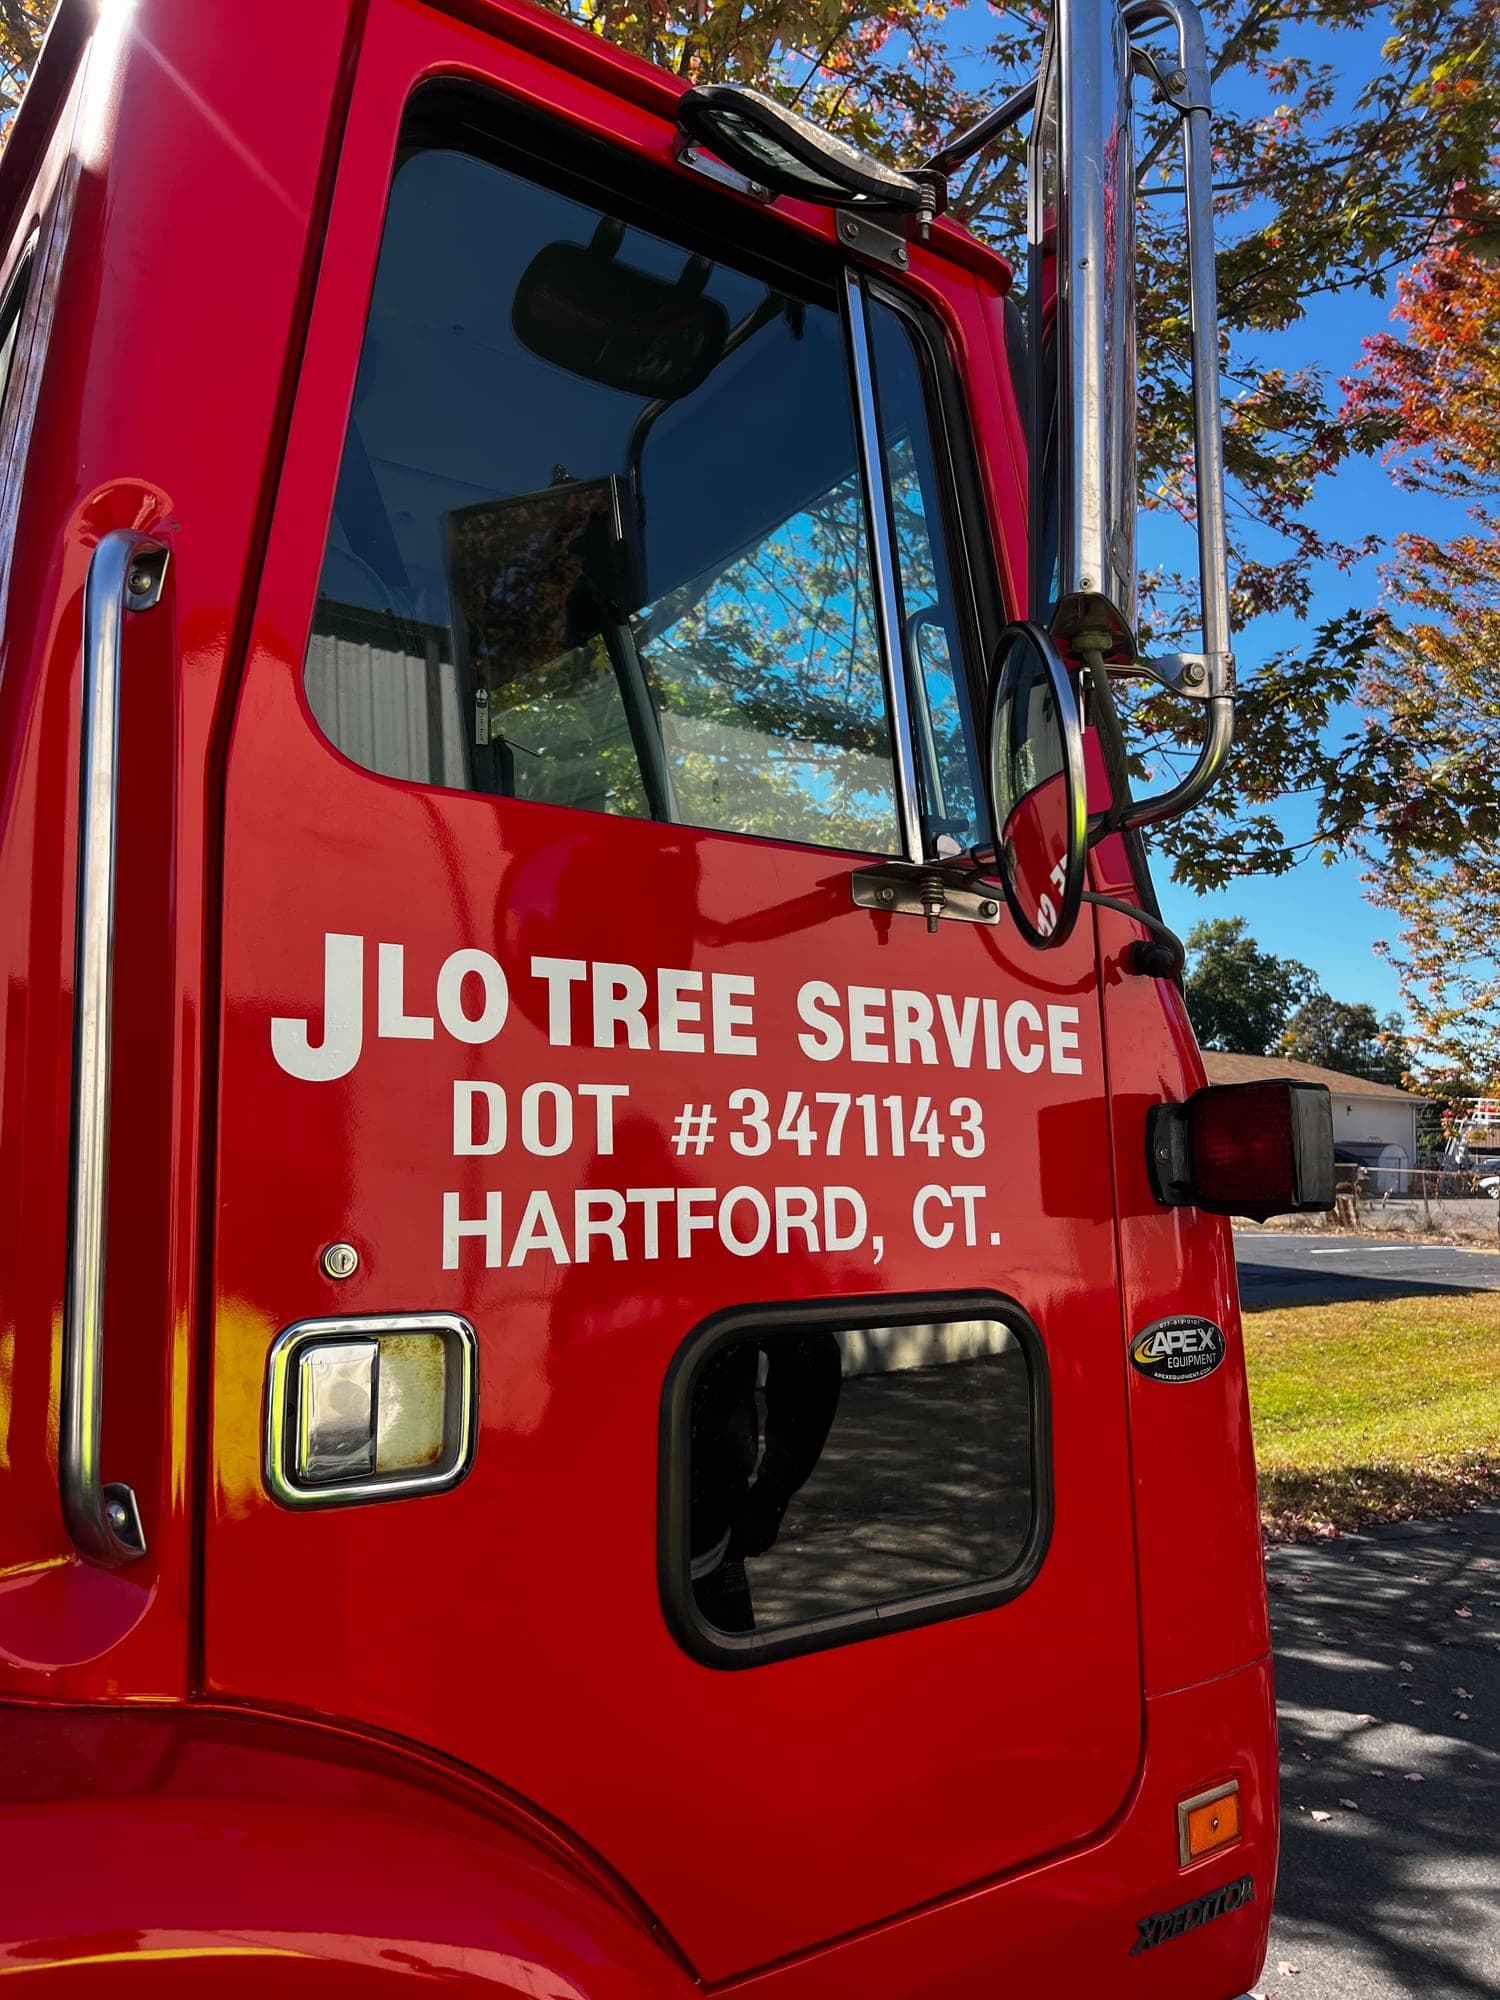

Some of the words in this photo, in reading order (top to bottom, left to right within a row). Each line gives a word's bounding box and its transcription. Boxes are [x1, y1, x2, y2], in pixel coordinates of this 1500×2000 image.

[270, 932, 509, 1082] JLO
[530, 956, 758, 1057] TREE
[797, 980, 1083, 1075] SERVICE
[453, 1080, 630, 1157] DOT
[670, 1088, 986, 1159] #3471143
[442, 1184, 885, 1271] HARTFORD,
[912, 1184, 1001, 1249] CT.
[1150, 1327, 1216, 1356] APEX
[1168, 1353, 1216, 1368] EQUIPMENT
